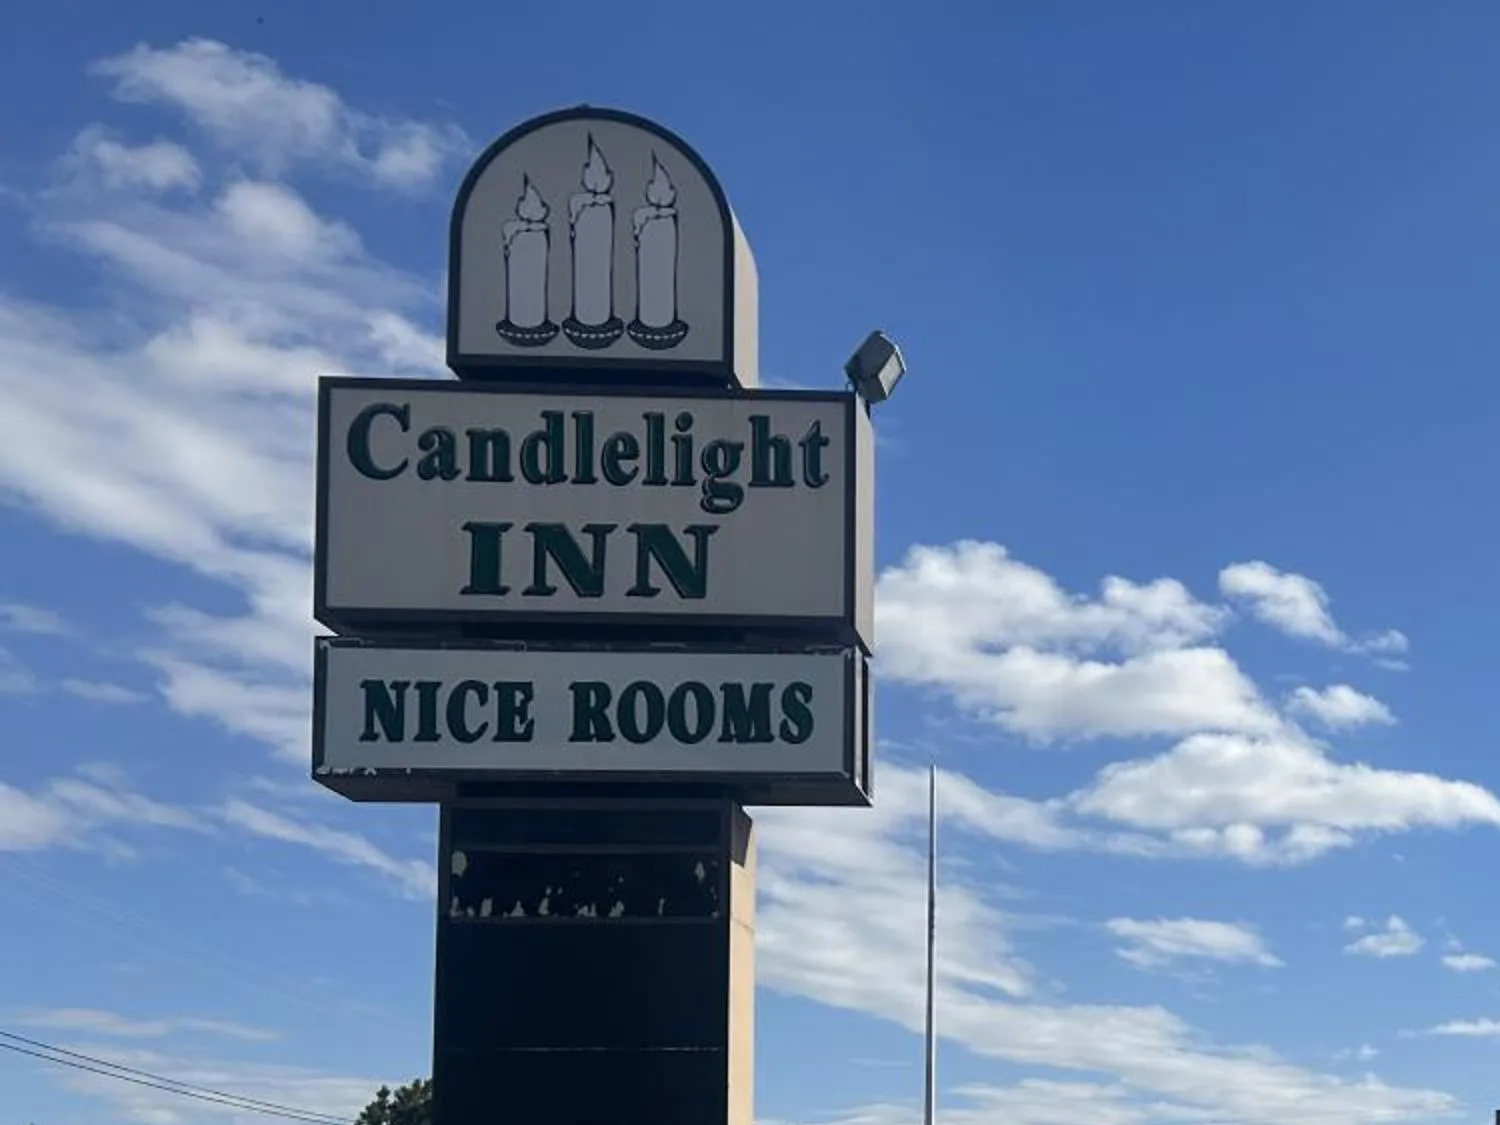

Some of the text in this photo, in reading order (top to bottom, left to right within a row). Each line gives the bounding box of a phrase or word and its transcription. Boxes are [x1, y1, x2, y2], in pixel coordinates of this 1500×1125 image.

[347, 402, 830, 513] Candlelight
[459, 521, 720, 599] INN
[358, 678, 814, 745] NICE ROOMS
